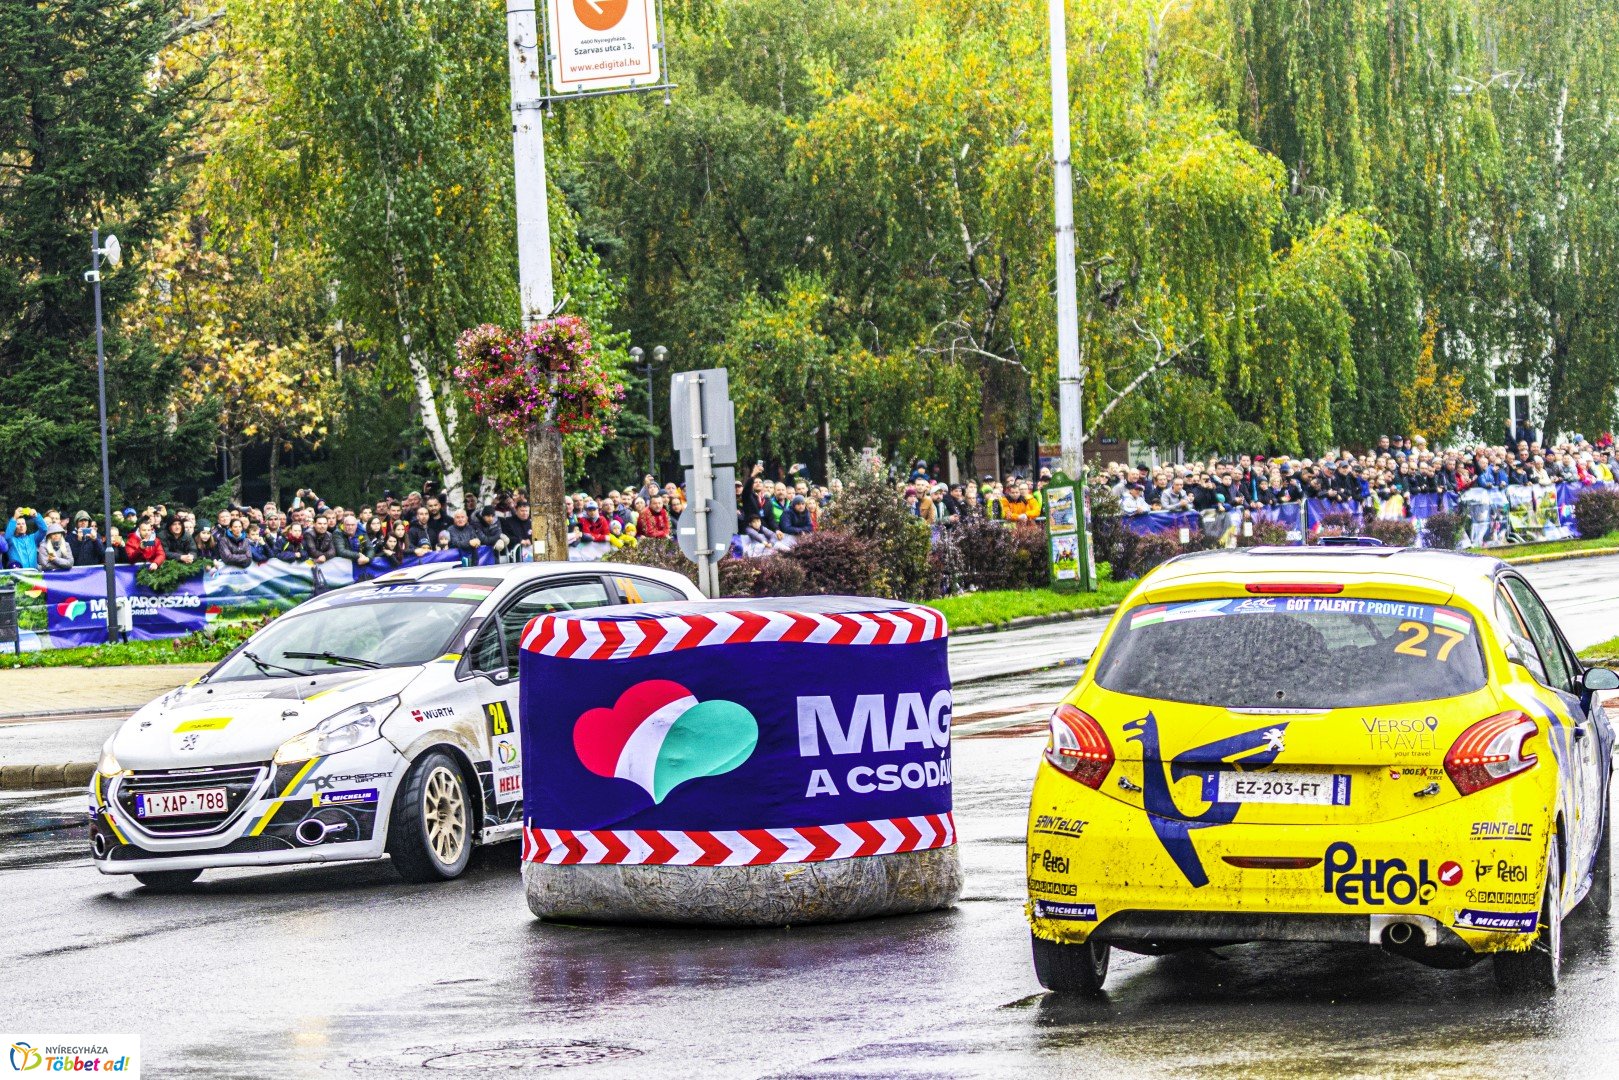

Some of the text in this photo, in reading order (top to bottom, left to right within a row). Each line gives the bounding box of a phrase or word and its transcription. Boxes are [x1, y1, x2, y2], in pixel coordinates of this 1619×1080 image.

[574, 42, 635, 56] Szarvas utca 13.
[570, 57, 641, 73] www.edigital.hu
[90, 592, 201, 612] MGYARORSZÁG
[1286, 599, 1312, 611] GOT
[1313, 599, 1365, 613] TALENT?
[1367, 603, 1406, 616] PROVE
[1406, 605, 1425, 620] IT!
[1394, 621, 1466, 662] 27
[423, 706, 455, 720] WÜRTH
[487, 702, 508, 736] 24
[796, 689, 952, 757] MAG
[1361, 717, 1425, 733] VERSO
[1364, 733, 1443, 750] TRAVEL
[332, 771, 393, 781] TOKSPORT
[500, 775, 521, 793] HELL
[805, 768, 840, 798] A
[1208, 775, 1214, 783] F
[332, 792, 372, 801] MICHELIN
[1235, 781, 1321, 796] EZ-203-FT
[1043, 849, 1070, 874] Petrol
[1324, 841, 1438, 906] Petrol
[1497, 859, 1528, 883] Petrol
[1030, 878, 1078, 897] BAUHAUS
[1477, 891, 1537, 904] BAUHAUS
[1046, 906, 1096, 915] MICHELIN
[1475, 916, 1533, 928] MICHELIN
